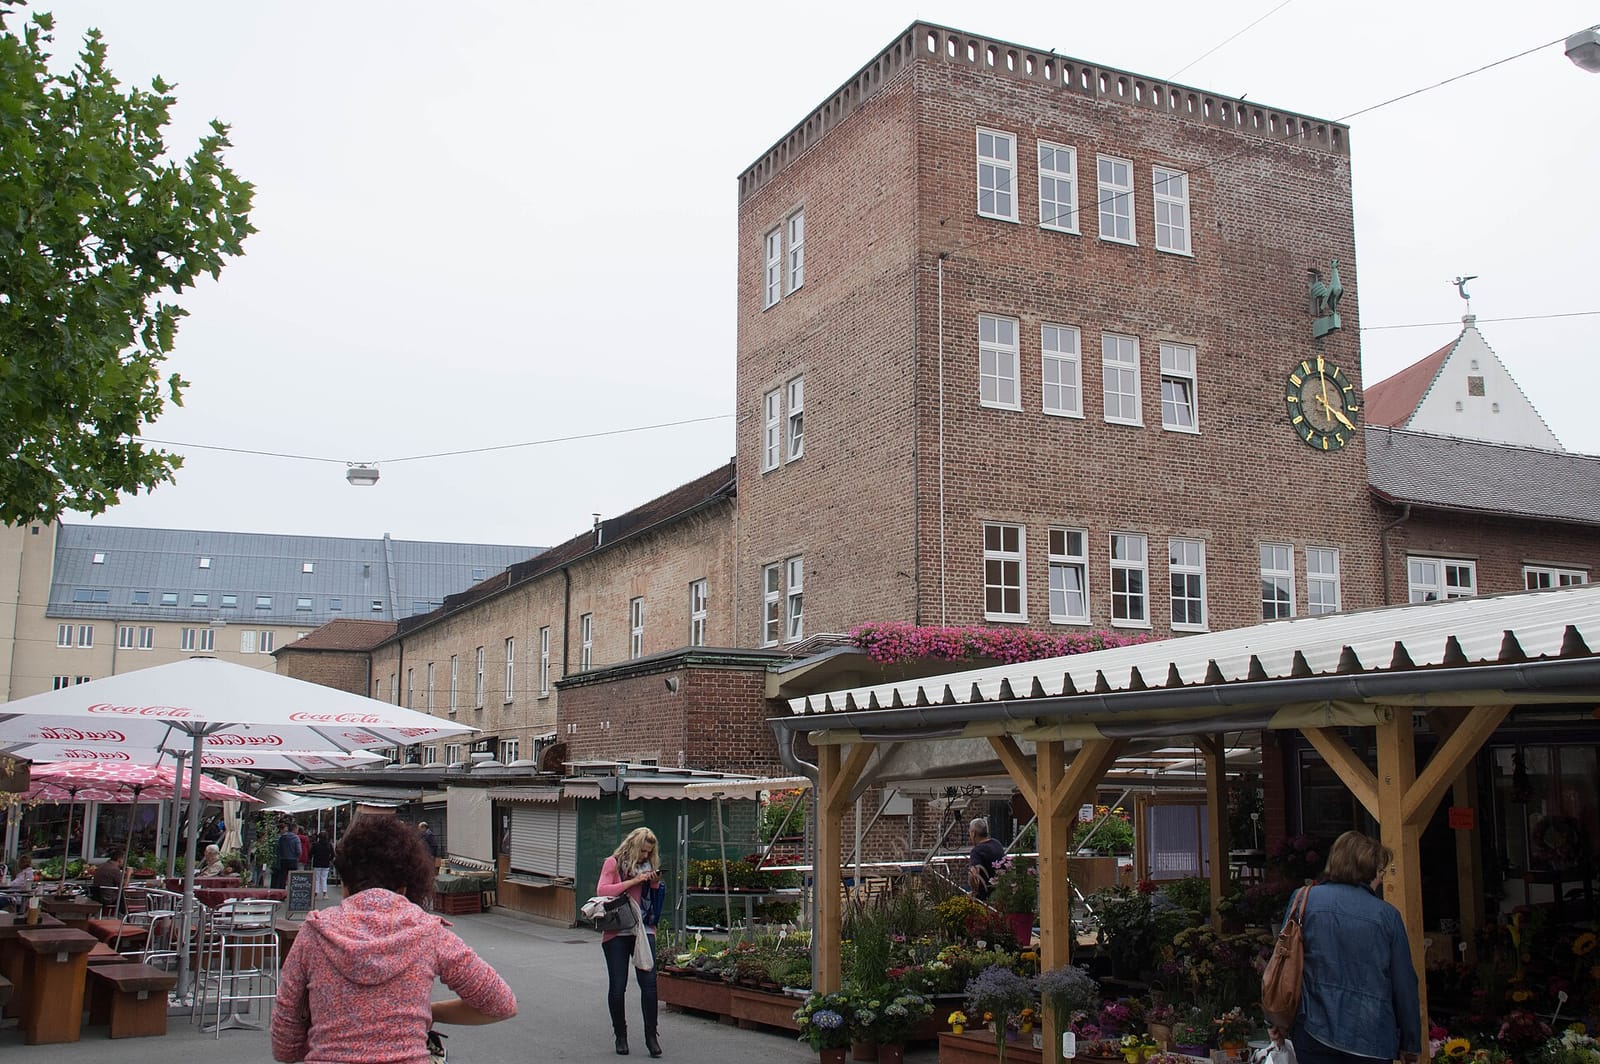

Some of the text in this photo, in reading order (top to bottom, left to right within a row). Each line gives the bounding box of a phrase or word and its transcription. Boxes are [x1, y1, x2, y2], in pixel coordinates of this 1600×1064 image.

[1301, 361, 1311, 375] 11
[1333, 367, 1340, 378] 1
[1290, 374, 1302, 387] 10
[1343, 384, 1353, 393] 2
[1293, 416, 1303, 424] 8
[1306, 430, 1314, 441] 7
[1336, 433, 1344, 446] 5
[1323, 437, 1328, 450] 6
